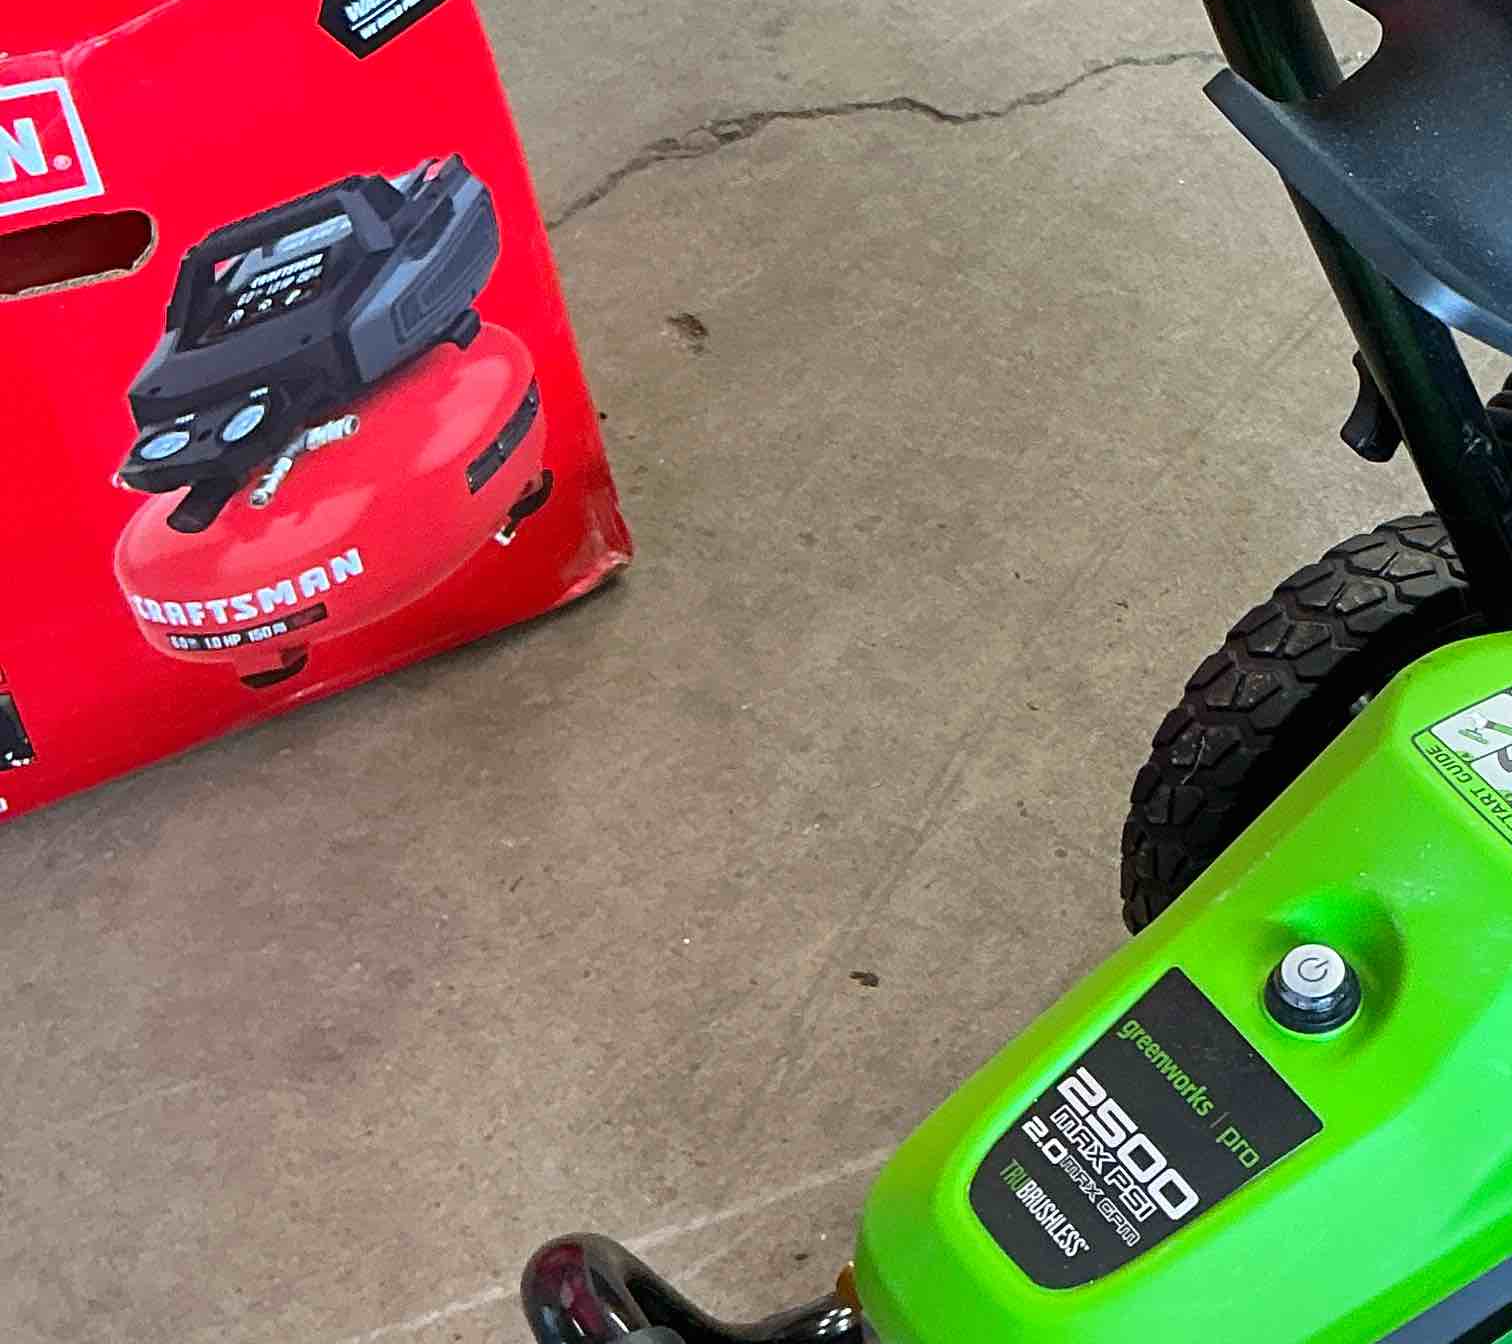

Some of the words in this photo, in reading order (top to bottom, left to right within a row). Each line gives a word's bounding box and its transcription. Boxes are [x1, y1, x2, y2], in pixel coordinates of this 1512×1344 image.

[131, 547, 365, 626] CRAFTSMAN
[1425, 744, 1473, 784] GUIDE
[1056, 1066, 1200, 1221] 2500
[1117, 1019, 1215, 1117] greenworks
[1215, 1126, 1261, 1169] pro
[1020, 1115, 1069, 1165] 2.0
[1059, 1154, 1105, 1204] MAX
[1096, 1197, 1142, 1248] GPM
[1049, 1104, 1117, 1175] MAX
[1103, 1165, 1158, 1223] PSI
